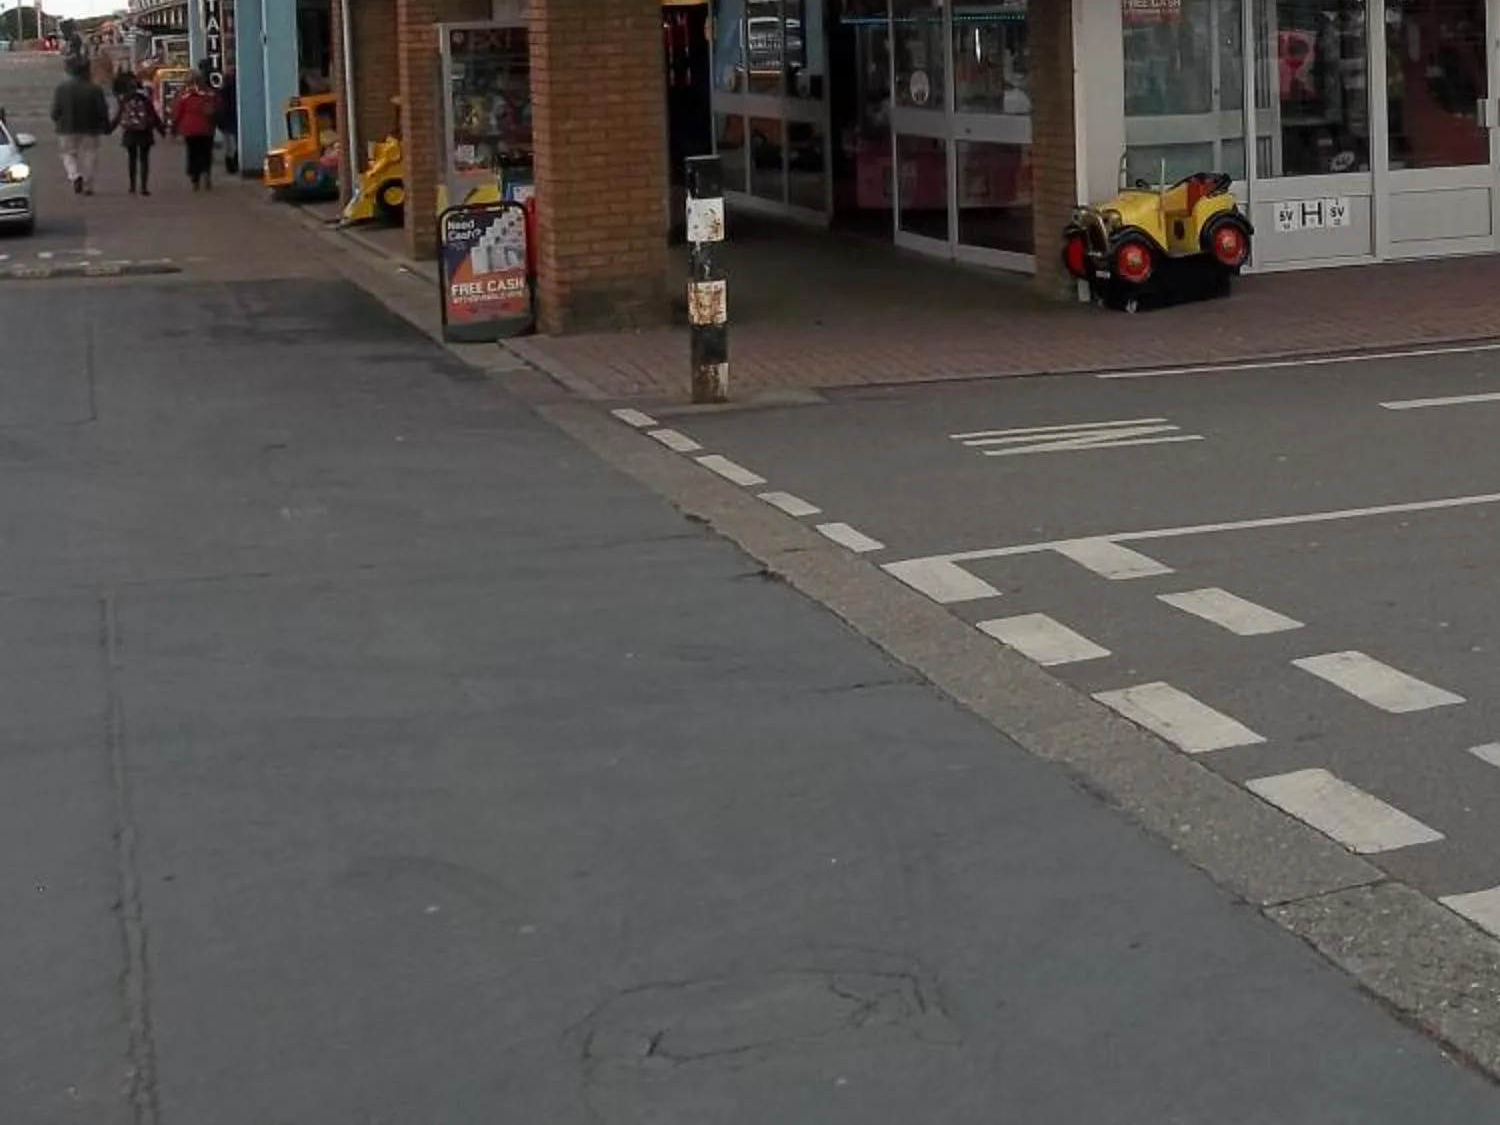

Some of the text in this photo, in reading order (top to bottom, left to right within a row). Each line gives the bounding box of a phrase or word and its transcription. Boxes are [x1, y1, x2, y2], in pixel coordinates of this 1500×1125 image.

[1302, 202, 1322, 225] H
[447, 219, 475, 230] Need
[447, 228, 482, 241] Cash?
[451, 277, 525, 296] FREE CASH
